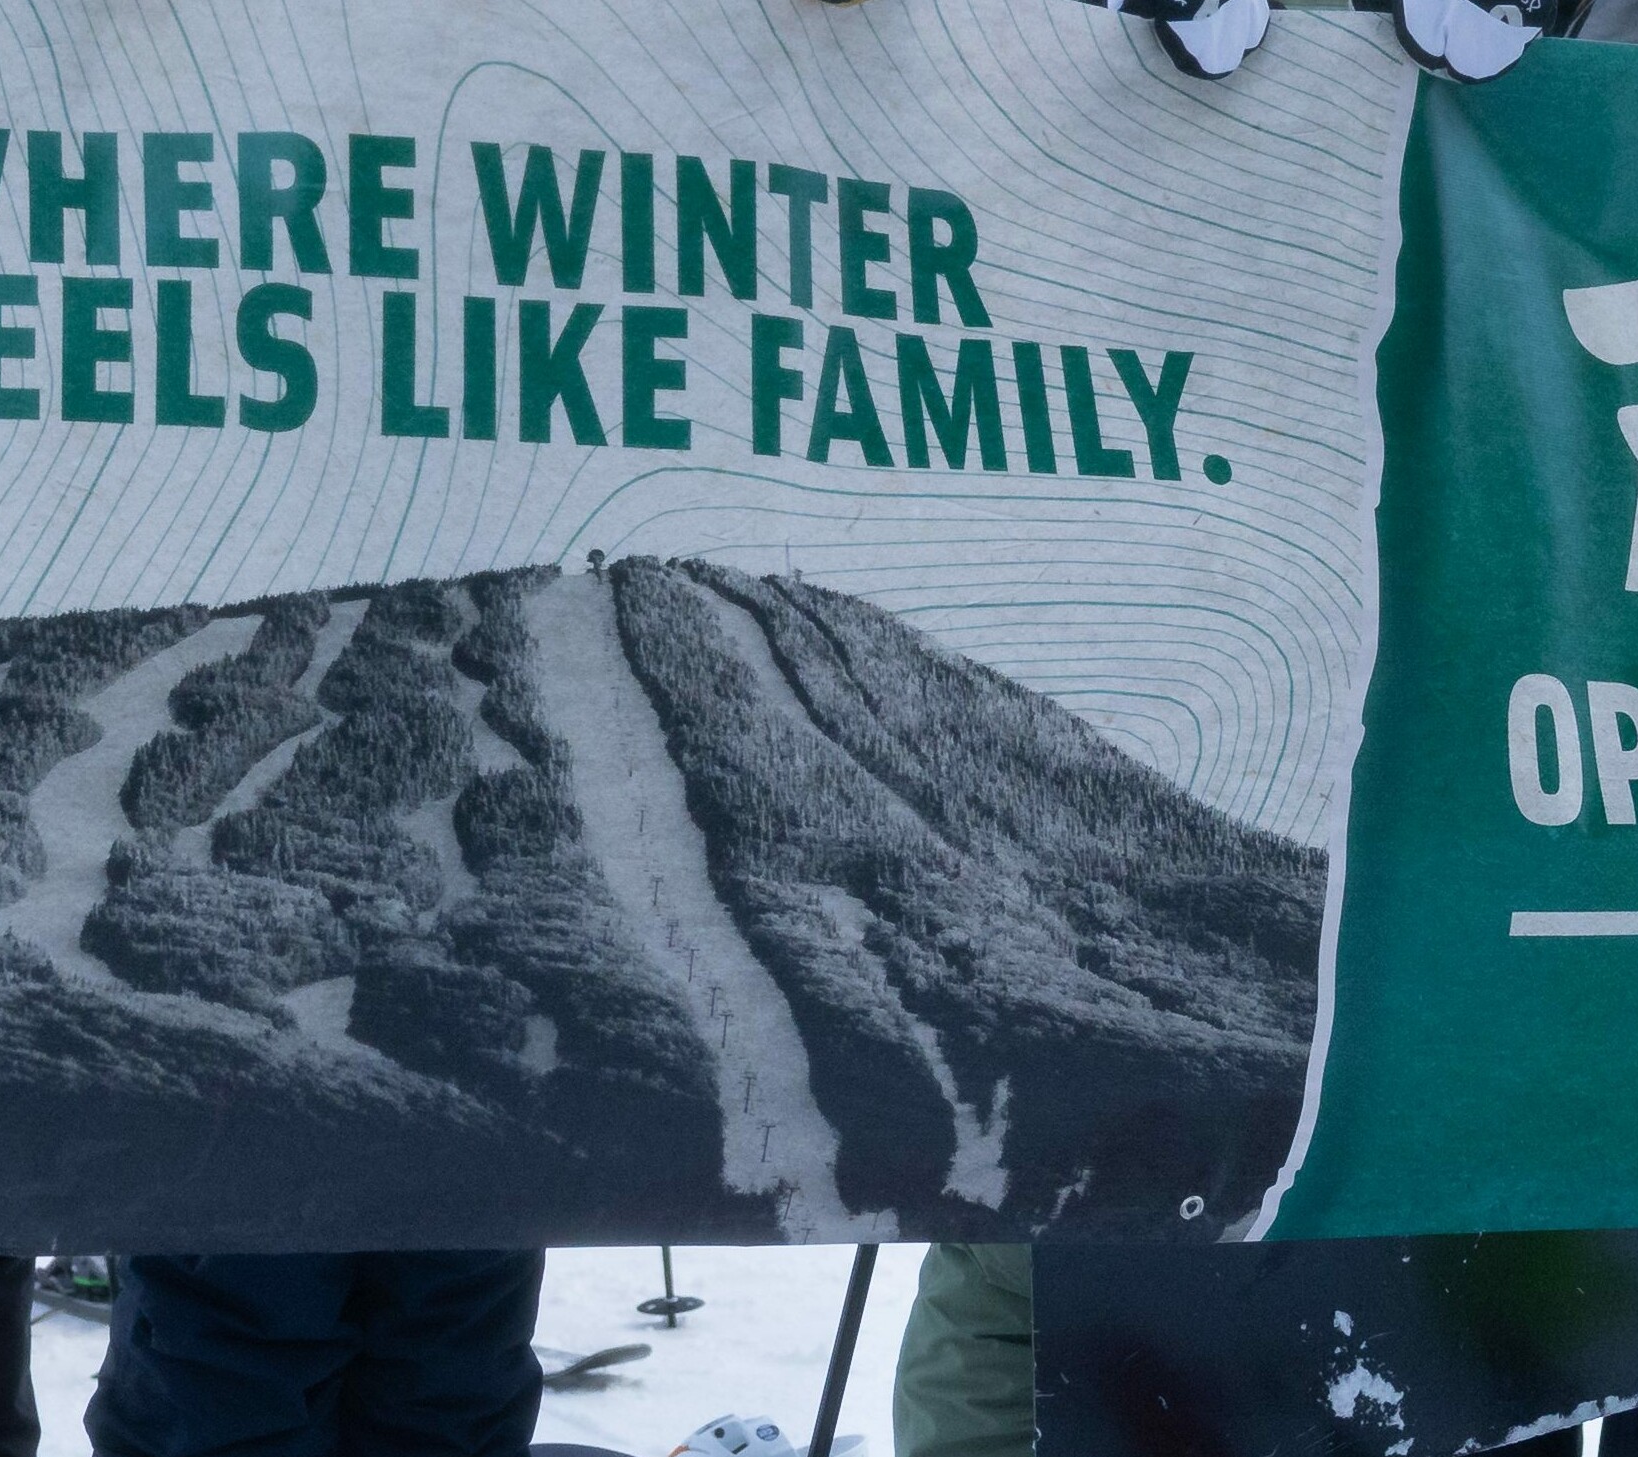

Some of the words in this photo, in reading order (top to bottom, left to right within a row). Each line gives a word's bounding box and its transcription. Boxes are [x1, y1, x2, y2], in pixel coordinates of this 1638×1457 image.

[472, 141, 994, 329] WINTER
[380, 290, 693, 451] LIKE
[750, 314, 1234, 486] FAMILY.
